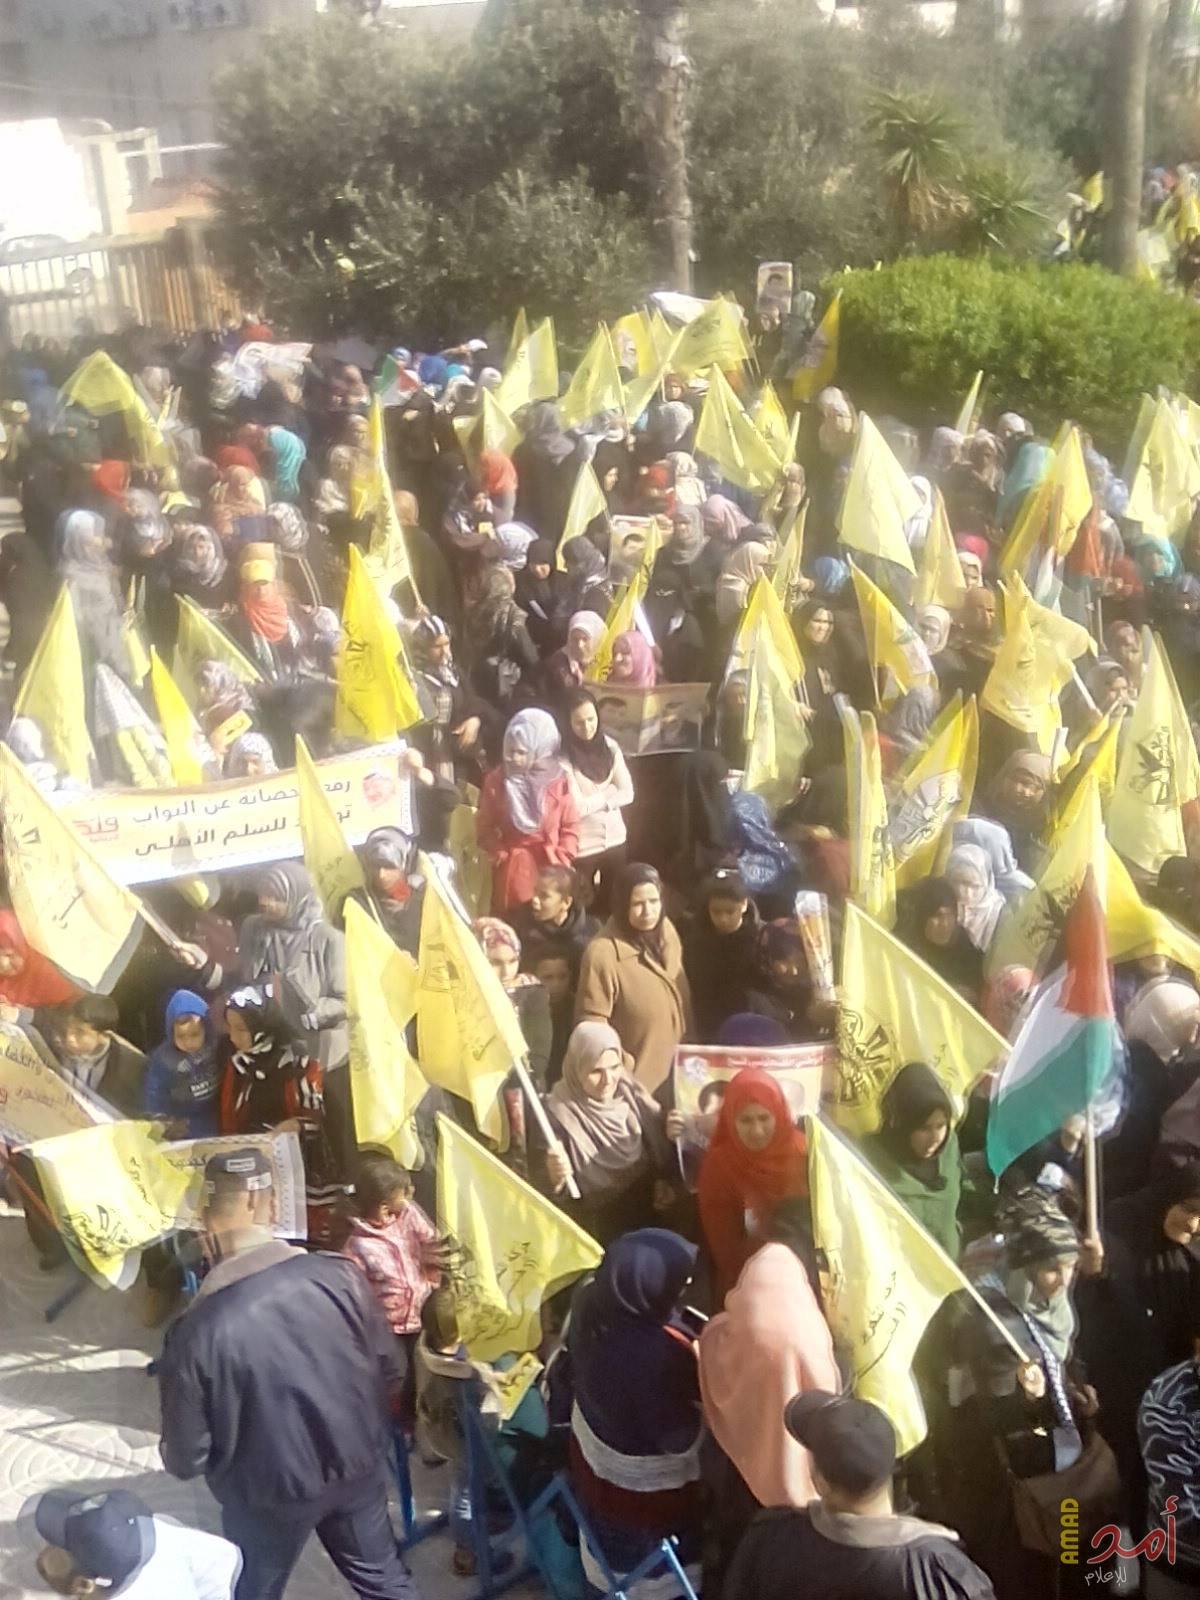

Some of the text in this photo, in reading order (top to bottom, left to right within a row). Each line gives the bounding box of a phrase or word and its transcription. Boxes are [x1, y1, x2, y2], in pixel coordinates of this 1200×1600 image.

[132, 799, 195, 824] النواب
[204, 799, 231, 815] عن
[223, 817, 286, 846] للسلم
